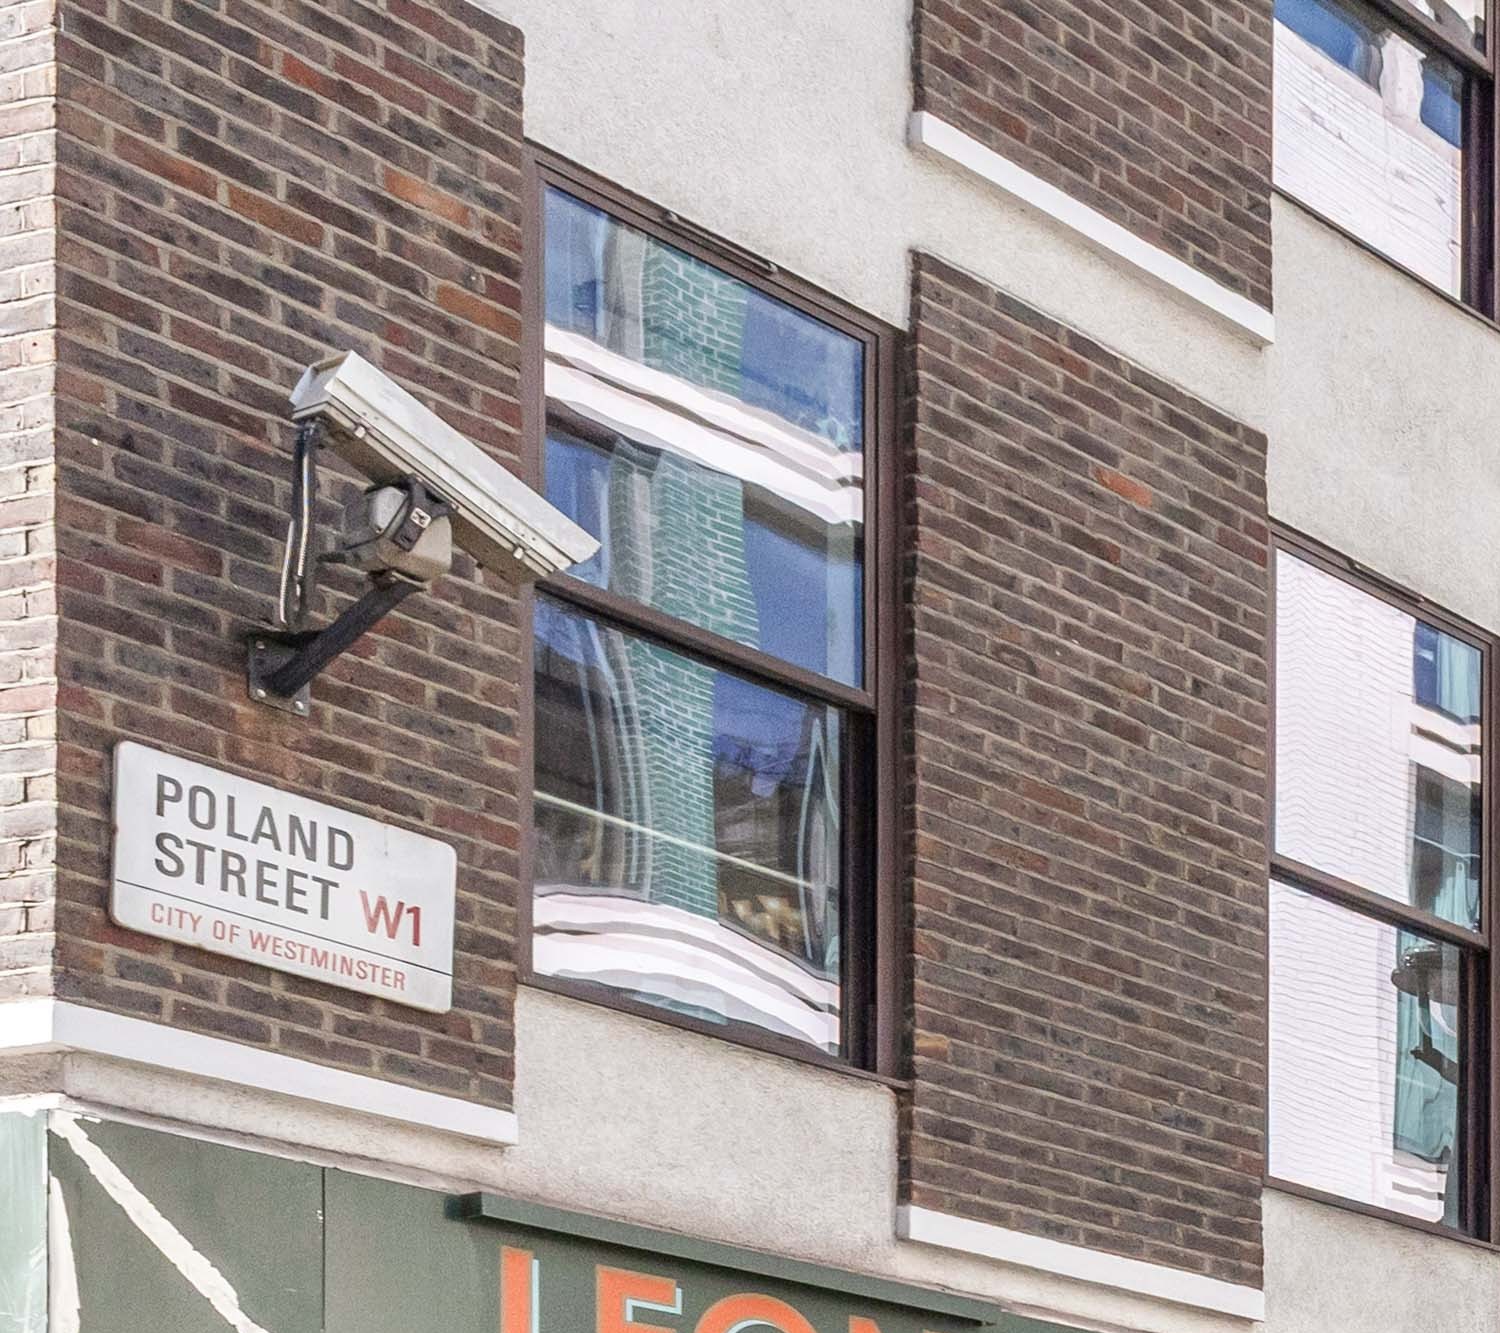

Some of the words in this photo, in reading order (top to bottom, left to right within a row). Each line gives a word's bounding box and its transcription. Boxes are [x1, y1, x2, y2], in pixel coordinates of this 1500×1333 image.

[155, 773, 356, 872] POLAND
[153, 832, 340, 920] STREET
[361, 894, 422, 949] W1
[150, 902, 206, 937] CITY
[211, 919, 242, 943] OF
[248, 927, 406, 992] WESTMINSTER
